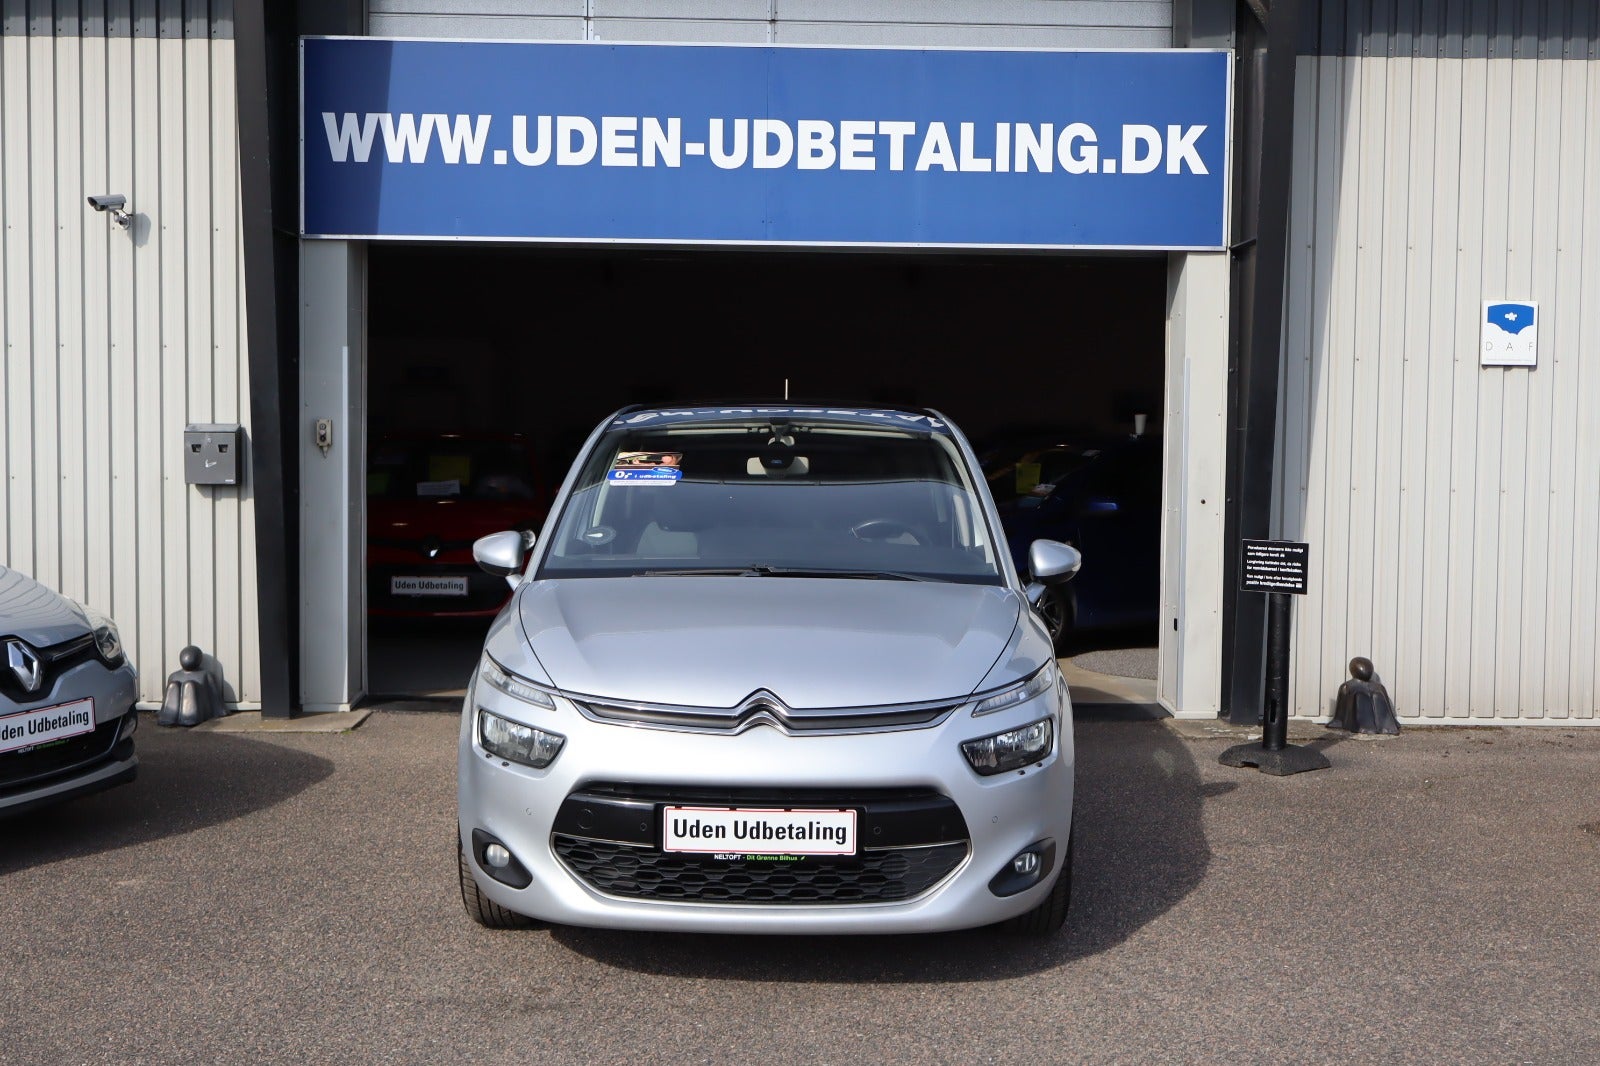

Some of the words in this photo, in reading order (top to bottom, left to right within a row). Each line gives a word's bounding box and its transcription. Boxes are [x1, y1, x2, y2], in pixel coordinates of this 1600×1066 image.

[321, 111, 1210, 175] WWW.UDEN-UDBETALING.DK
[395, 580, 417, 589] Uden
[418, 580, 464, 591] Udbetaling
[0, 725, 24, 740] den
[28, 710, 89, 735] Udbetaling
[673, 818, 726, 838] Uden
[733, 820, 847, 845] Udbetaling
